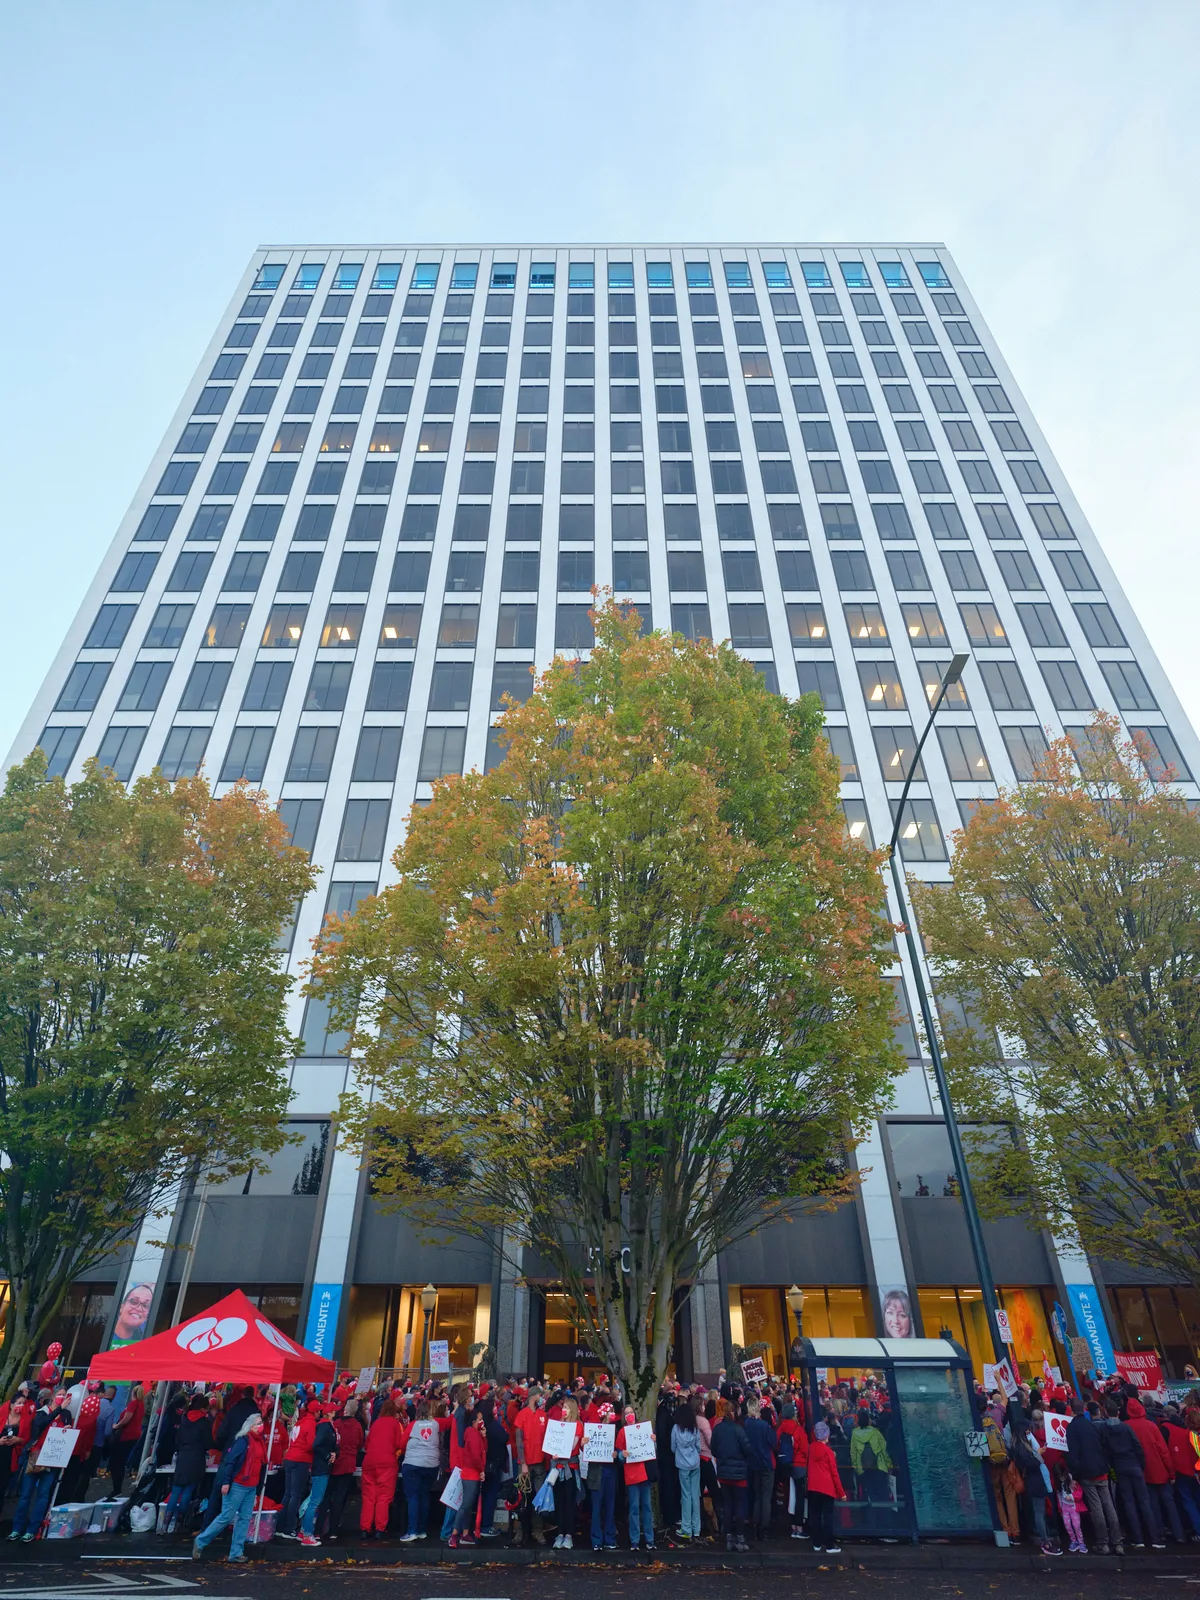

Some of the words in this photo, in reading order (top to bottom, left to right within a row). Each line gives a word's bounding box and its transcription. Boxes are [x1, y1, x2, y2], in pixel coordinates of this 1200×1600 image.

[313, 1301, 330, 1355] MANENTE
[1128, 1355, 1148, 1369] HEAR
[1145, 1355, 1158, 1368] US
[1126, 1370, 1150, 1387] NOW?
[588, 1429, 607, 1440] SAFE
